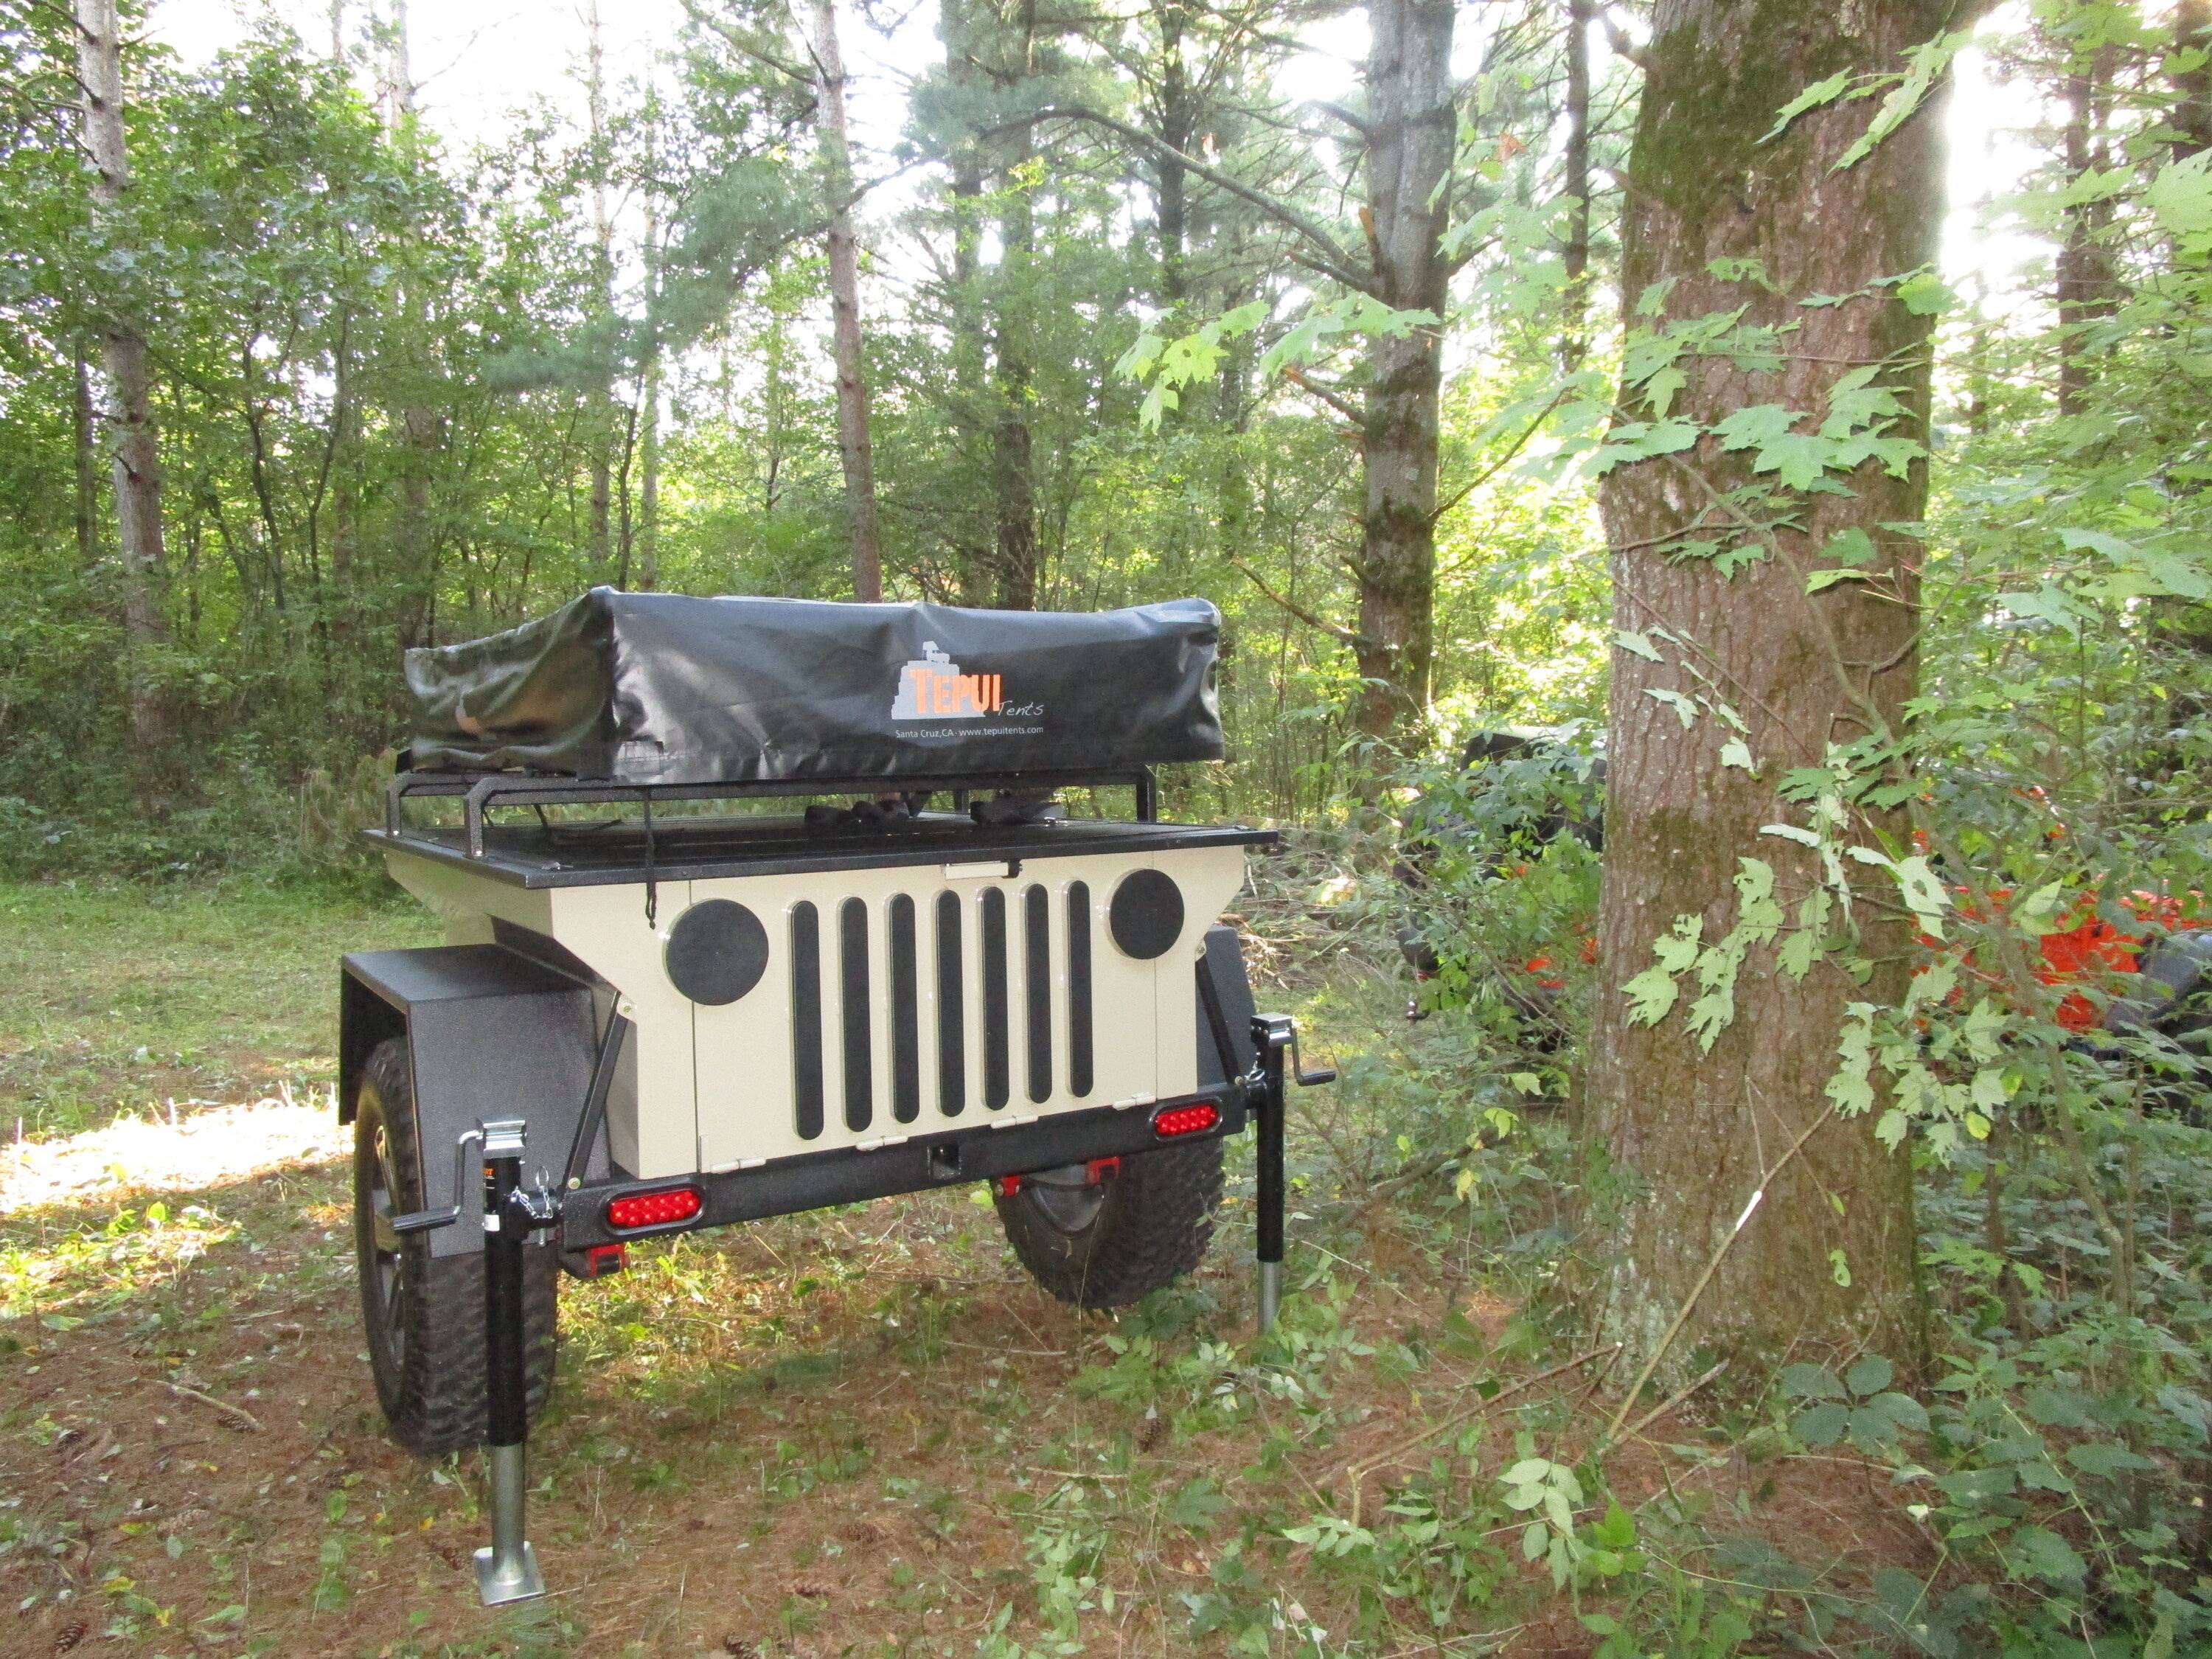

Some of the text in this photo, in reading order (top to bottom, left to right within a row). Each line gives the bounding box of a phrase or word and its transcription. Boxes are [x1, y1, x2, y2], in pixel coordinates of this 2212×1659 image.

[908, 668, 1001, 714] TEPUI
[997, 700, 1045, 717] Tents
[895, 729, 919, 738] Santa
[959, 726, 1044, 737] www.tepuitents.com
